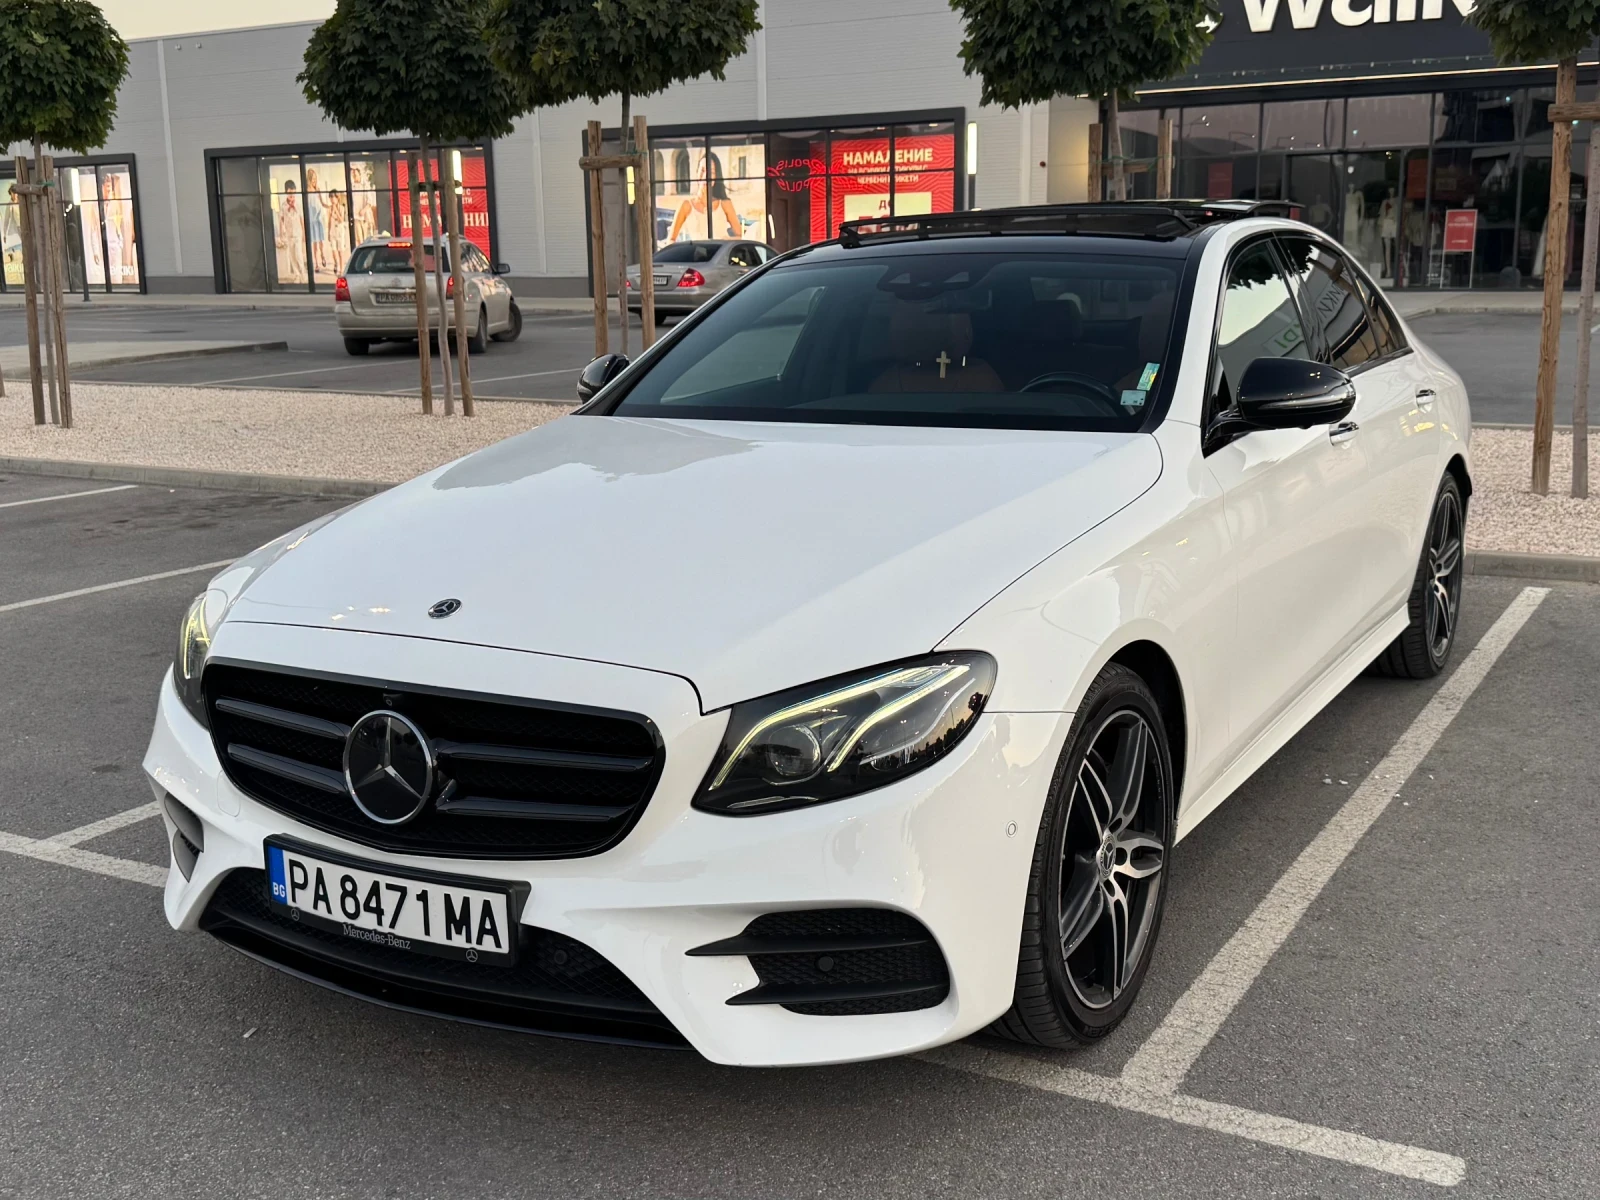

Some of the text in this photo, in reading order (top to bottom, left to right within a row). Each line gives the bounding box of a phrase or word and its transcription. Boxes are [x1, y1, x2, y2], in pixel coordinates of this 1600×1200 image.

[272, 882, 286, 898] BG
[289, 858, 502, 949] PA 8471 MA
[342, 923, 411, 950] Mercedes-Benz
